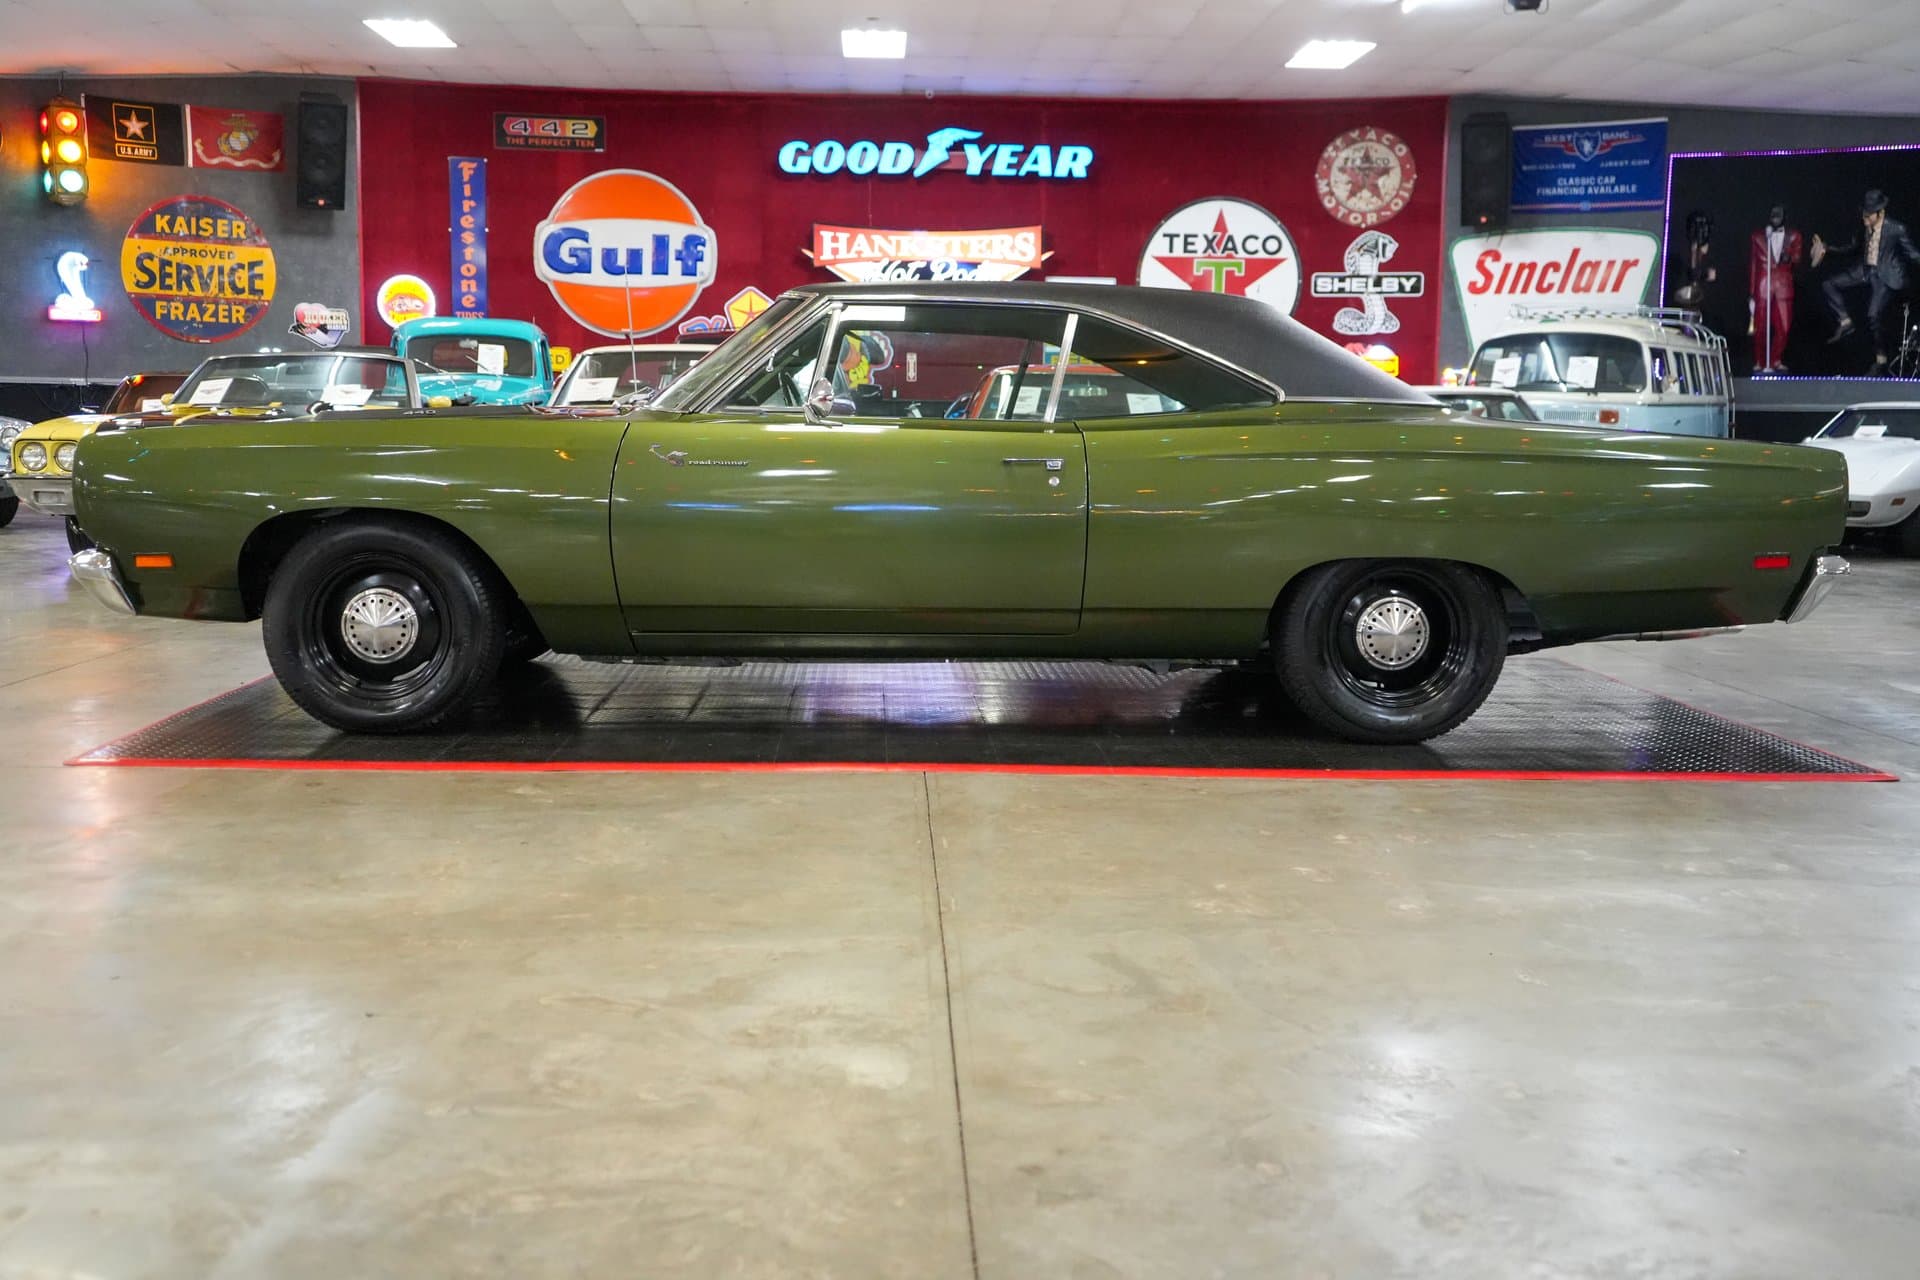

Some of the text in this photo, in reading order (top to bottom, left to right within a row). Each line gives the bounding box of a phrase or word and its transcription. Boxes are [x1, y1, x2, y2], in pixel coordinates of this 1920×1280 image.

[134, 147, 153, 157] ARMY
[506, 137, 595, 148] THE PERFECT TEN
[1536, 184, 1638, 197] FINANCING AVAILABLE
[1557, 175, 1617, 186] CLASSIC CAR
[155, 213, 247, 240] KAISER
[458, 161, 477, 308] Firestone
[163, 246, 236, 260] APPROVED
[542, 226, 707, 277] Gulf
[1162, 232, 1283, 256] TEXACO
[134, 251, 265, 297] SERVICE
[928, 256, 1000, 282] Rod
[1467, 247, 1640, 295] Sinclair
[1315, 276, 1418, 293] SHELBY
[155, 300, 246, 324] FRAZER
